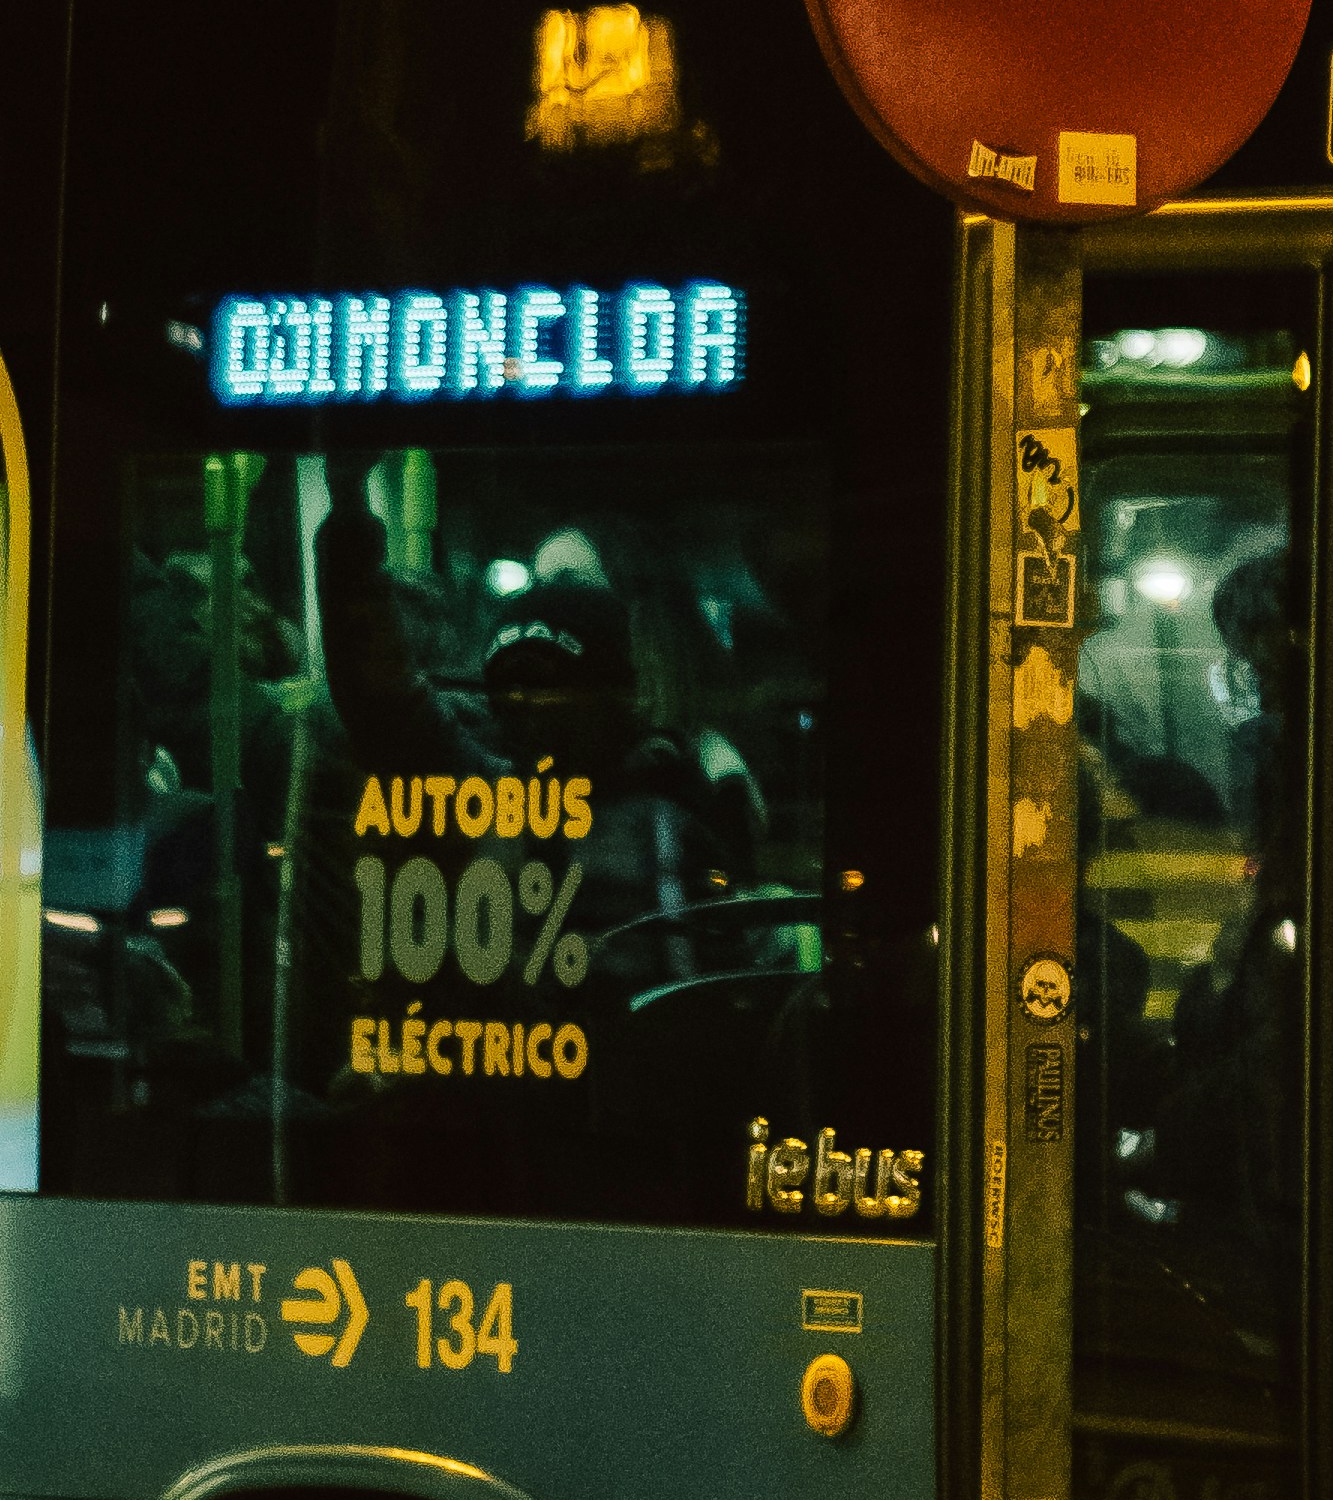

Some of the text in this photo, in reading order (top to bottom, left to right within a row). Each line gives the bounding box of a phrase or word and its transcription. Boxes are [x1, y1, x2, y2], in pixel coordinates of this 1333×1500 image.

[342, 283, 741, 397] MONCLOA
[355, 757, 592, 839] AUTOBÚS
[354, 856, 587, 988] 100%
[351, 1002, 588, 1079] ELÉCTRICO
[188, 1260, 268, 1304] EMT
[117, 1305, 269, 1354] MADRID
[404, 1278, 518, 1374] 134
